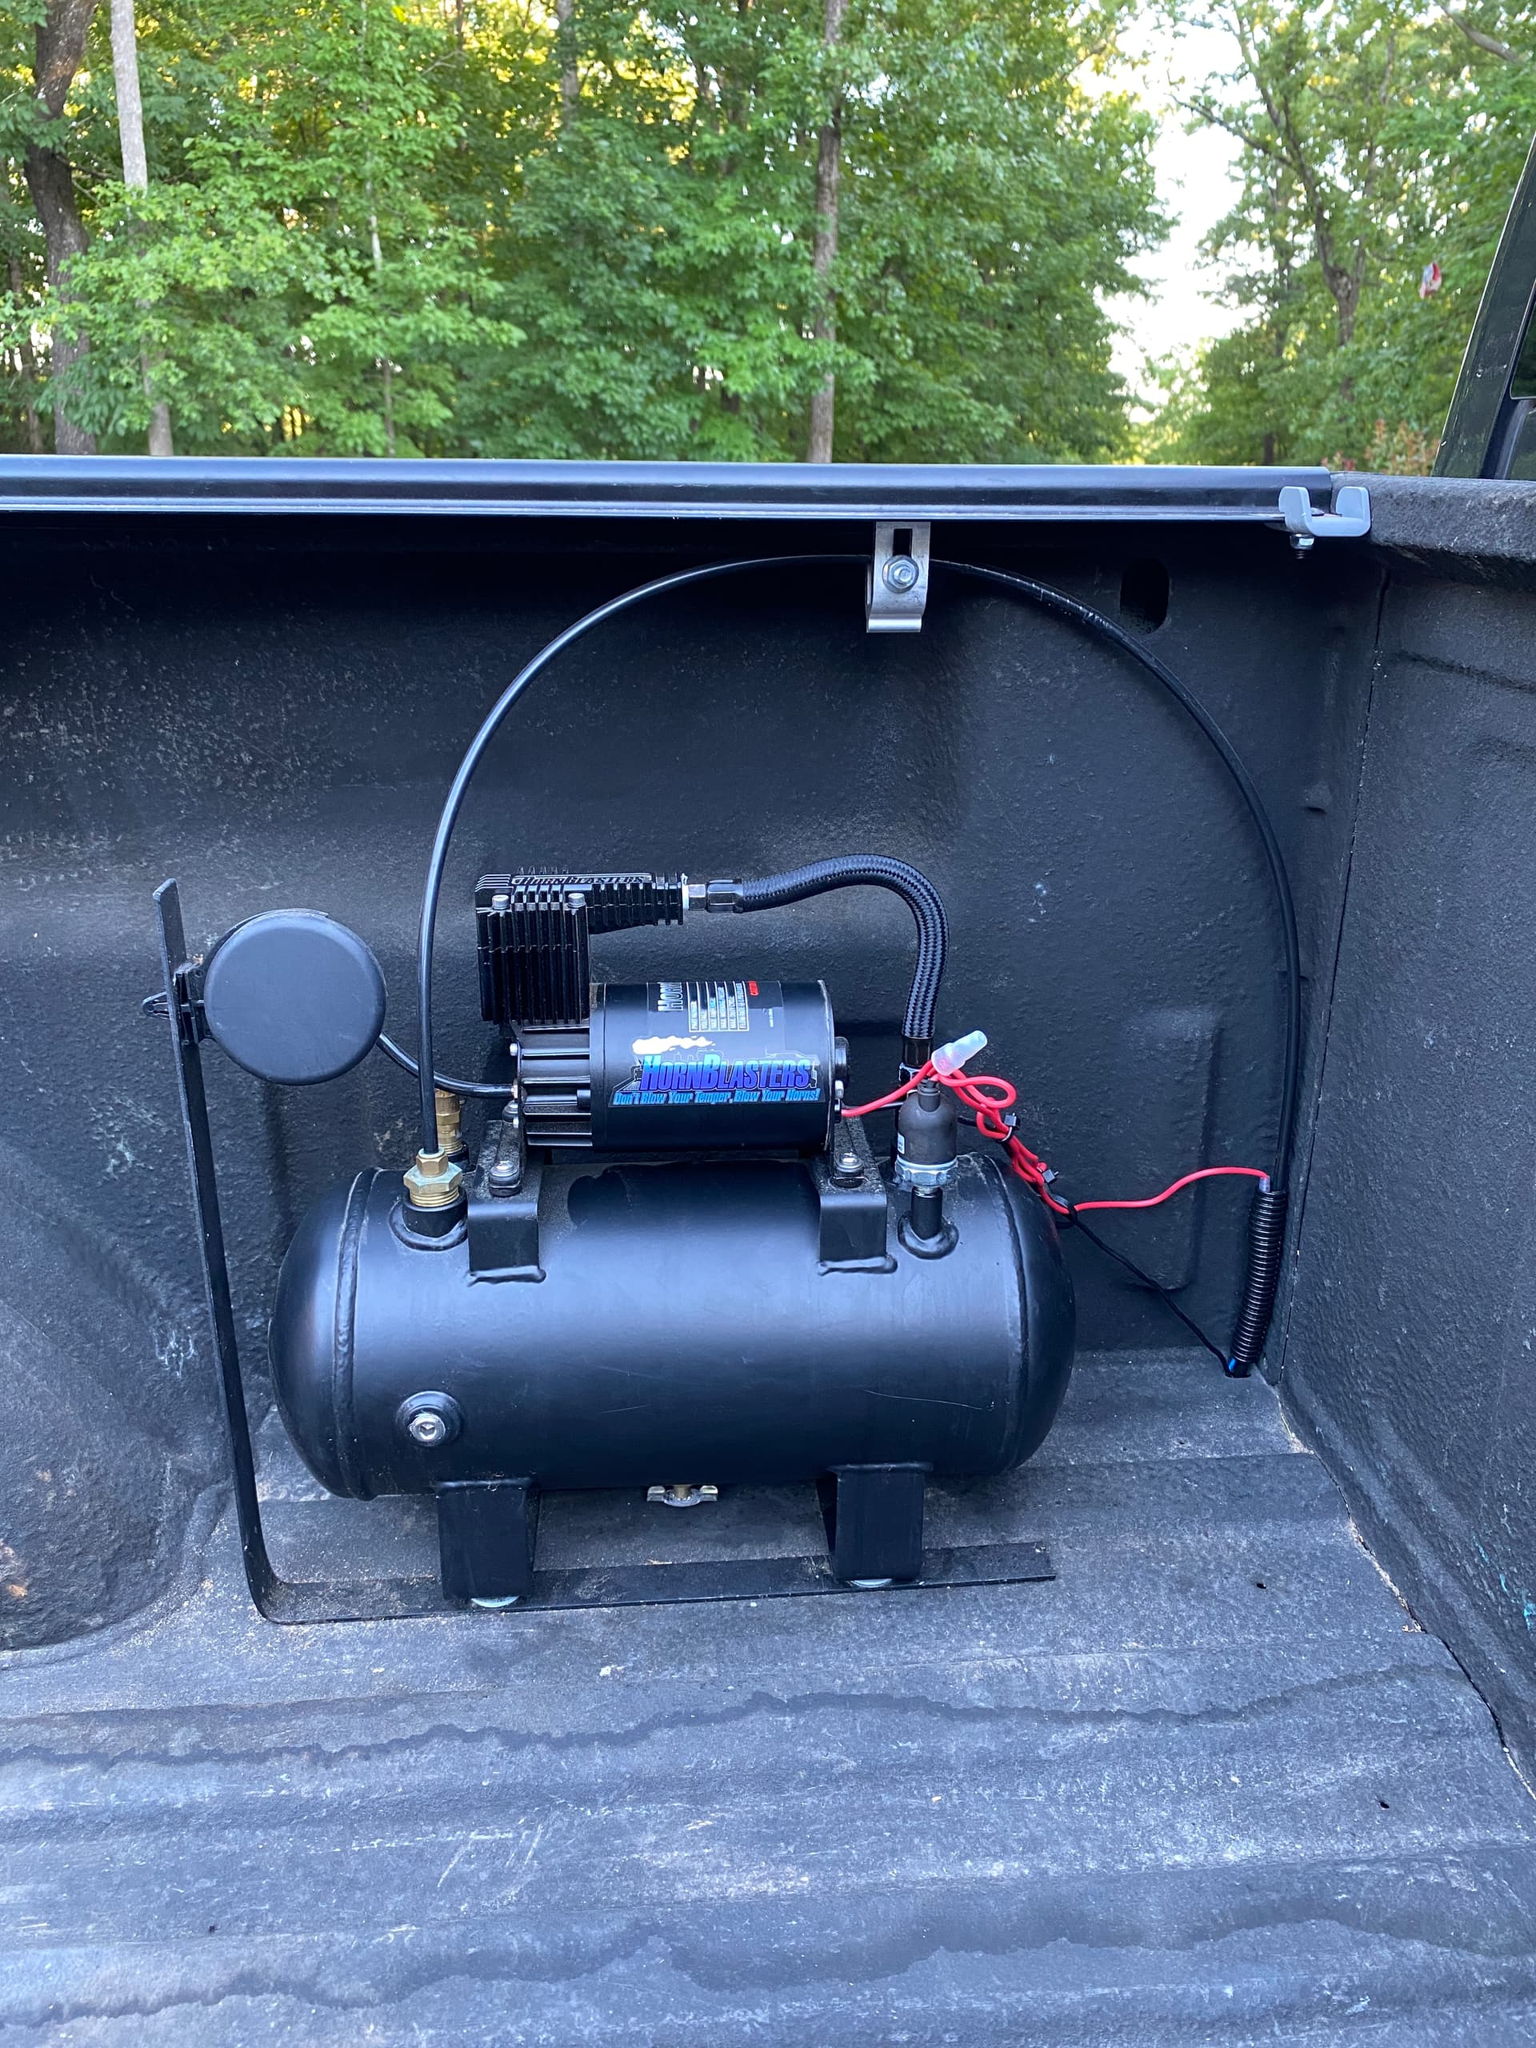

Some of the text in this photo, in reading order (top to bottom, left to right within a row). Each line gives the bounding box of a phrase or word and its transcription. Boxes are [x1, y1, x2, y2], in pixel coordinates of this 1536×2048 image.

[640, 1091, 668, 1104] Blow
[668, 1091, 693, 1104] Your
[734, 1089, 760, 1103] Blow
[761, 1089, 786, 1102] Your
